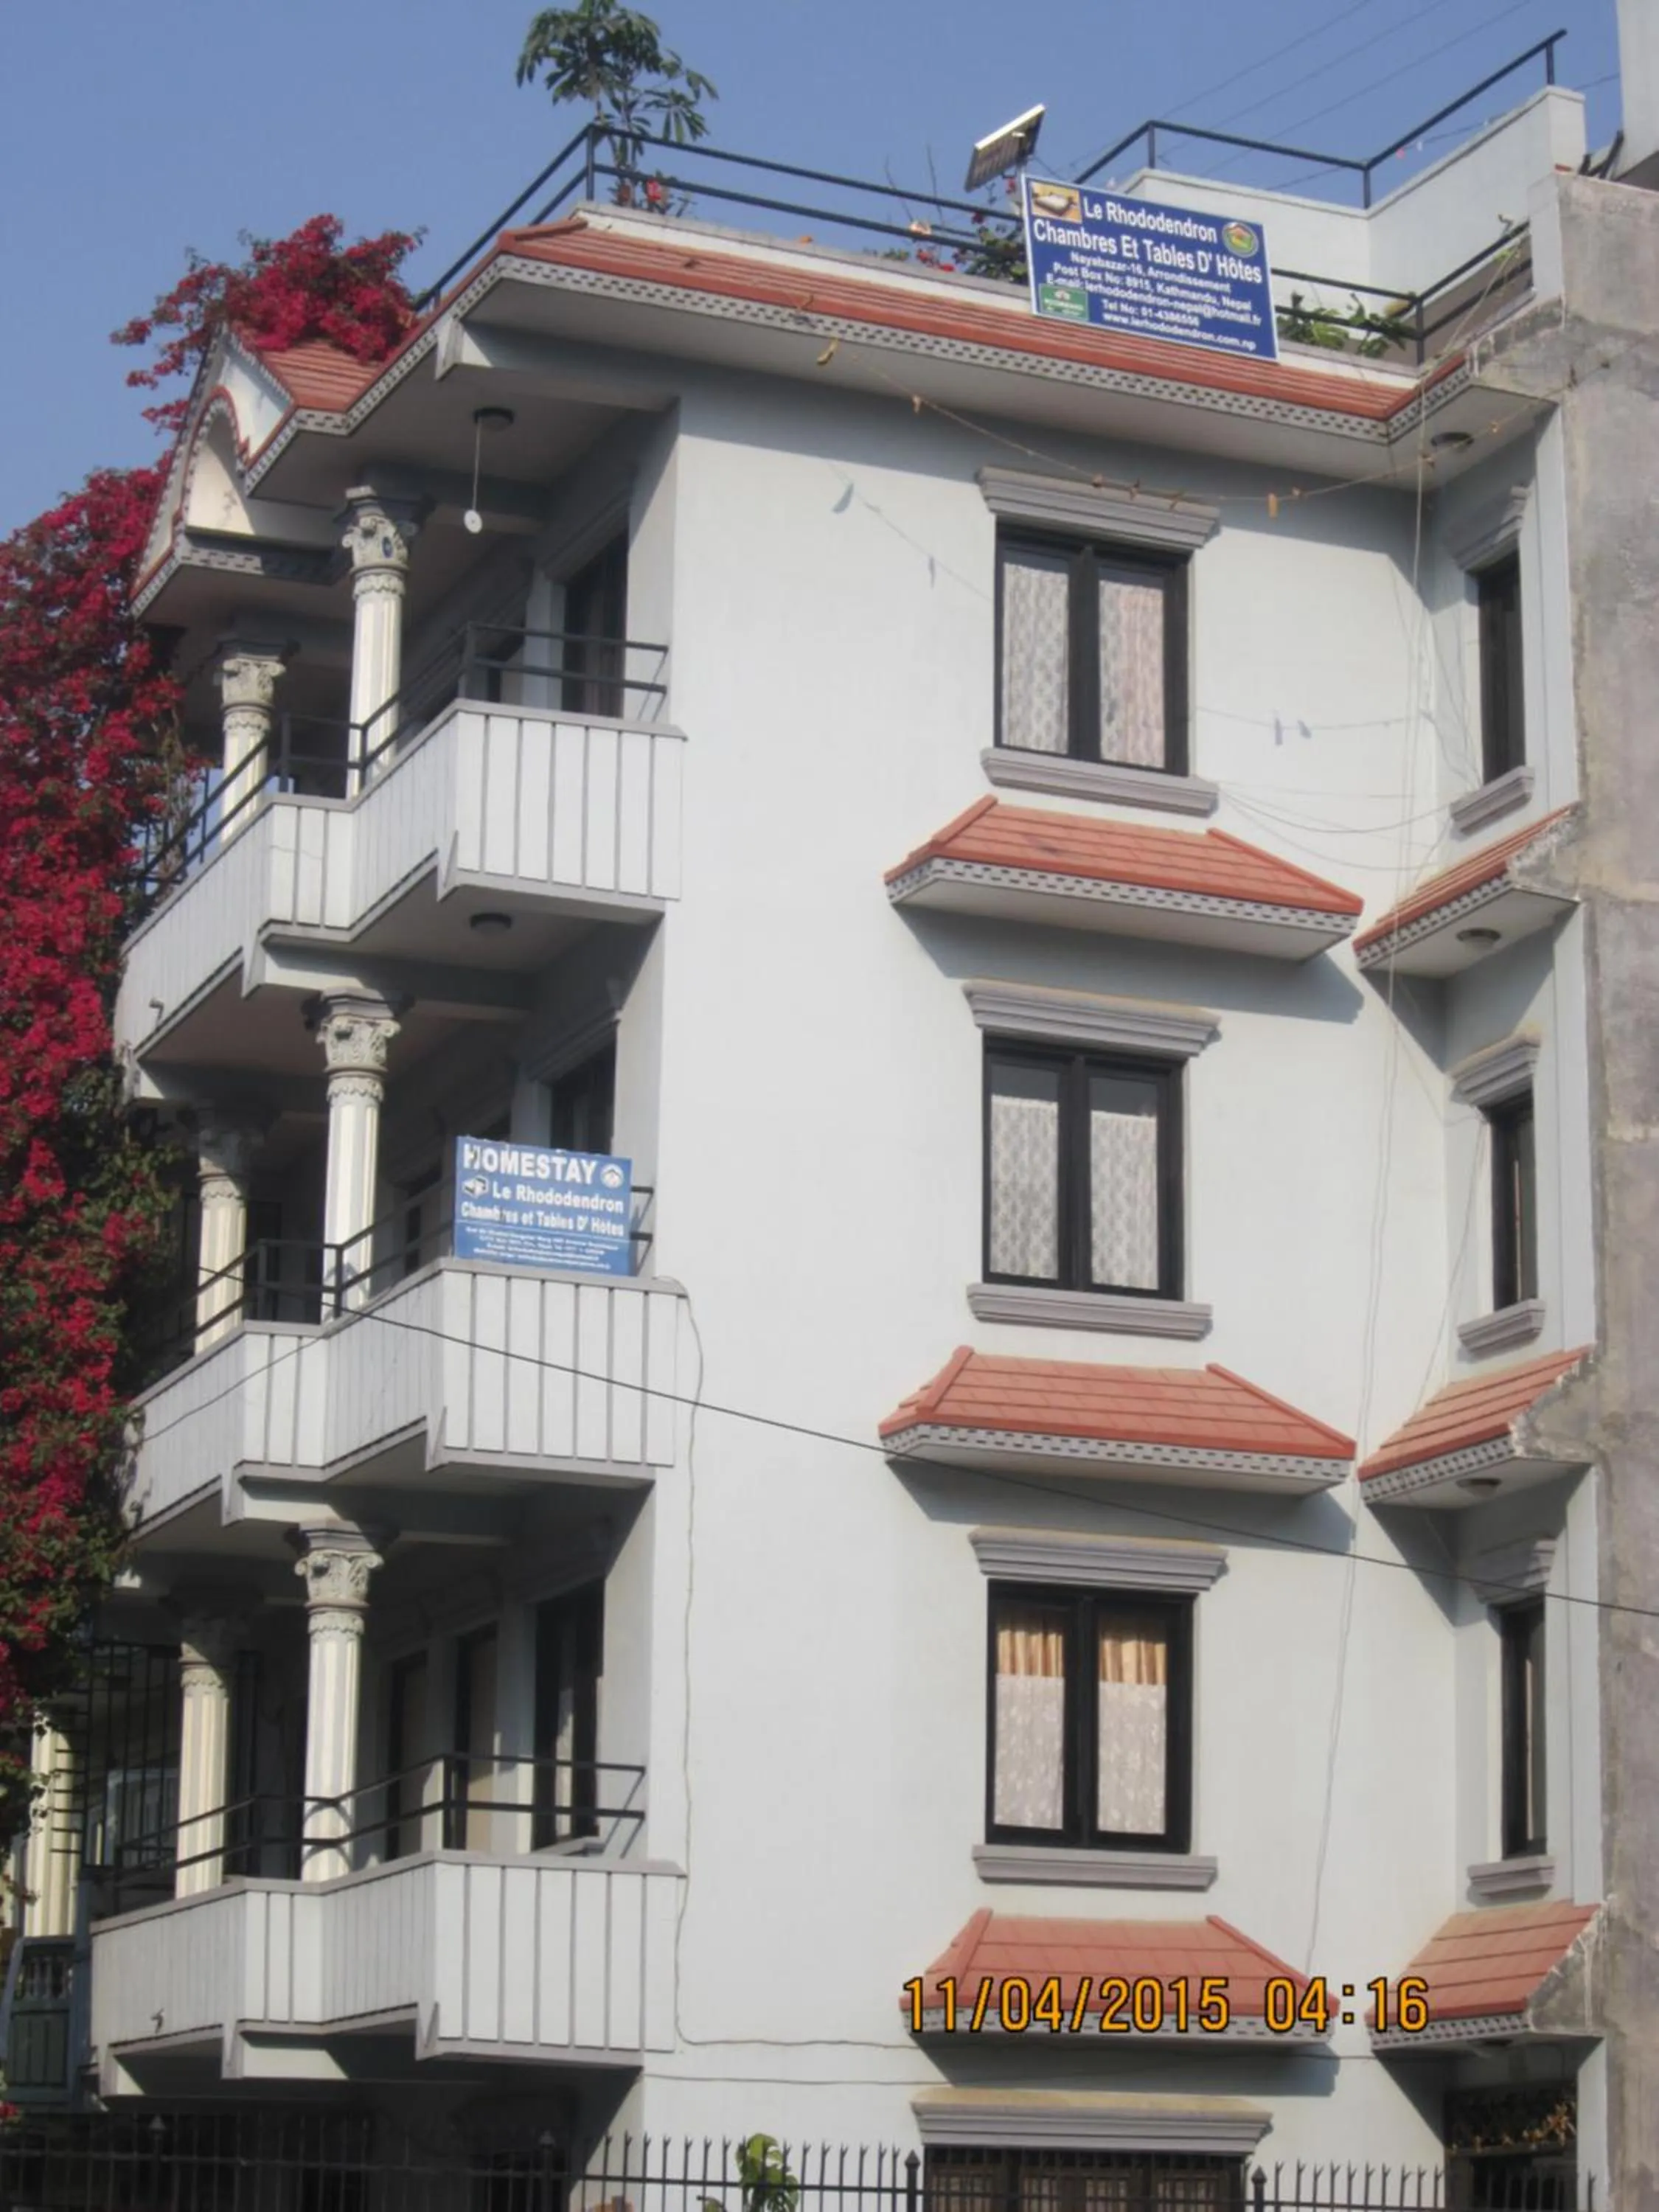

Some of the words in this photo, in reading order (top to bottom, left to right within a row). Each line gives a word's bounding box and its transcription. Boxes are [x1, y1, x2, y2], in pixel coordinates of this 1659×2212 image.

[1083, 196, 1102, 220] Le
[1107, 202, 1217, 243] Rhododendron
[1034, 219, 1117, 255] Chambres
[1121, 235, 1138, 260] Et
[1143, 240, 1194, 272] Tables
[1216, 254, 1262, 284] Hôtes
[1053, 262, 1078, 278] Post
[1082, 267, 1102, 282] Box
[1222, 296, 1252, 312] Nepal
[1148, 267, 1231, 293] Arrondissement
[1102, 299, 1119, 311] Tel
[464, 1144, 597, 1185] HOMESTAY
[493, 1182, 510, 1199] Le
[516, 1185, 624, 1213] Rhododendron
[522, 1211, 533, 1225] et
[537, 1211, 574, 1230] Tables
